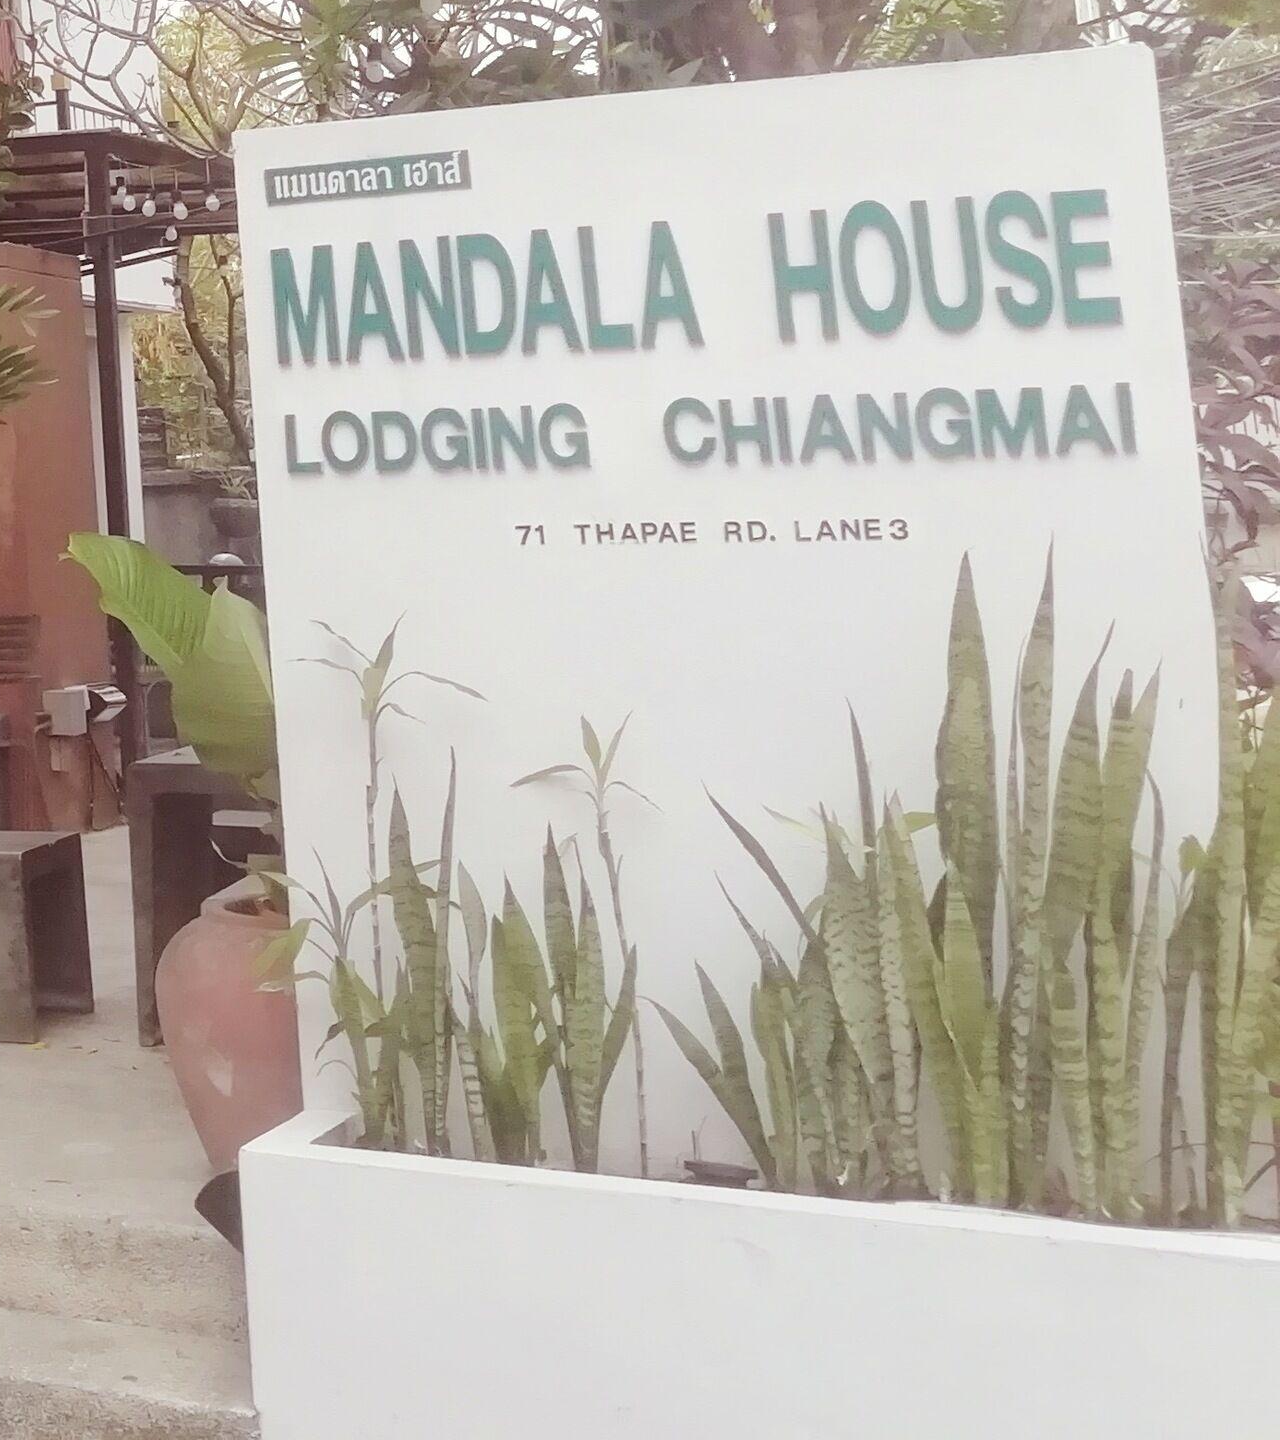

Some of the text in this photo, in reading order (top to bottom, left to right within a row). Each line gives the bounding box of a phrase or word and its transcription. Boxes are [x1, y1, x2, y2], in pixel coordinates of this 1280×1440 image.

[273, 150, 462, 200] แมนดาลา เฮาส์
[270, 188, 1124, 366] MANDALA HOUSE
[283, 382, 1138, 475] LODGING CHIANGMAI
[514, 524, 547, 546] 71
[572, 521, 699, 546] THAPAE
[723, 519, 778, 544] RD.
